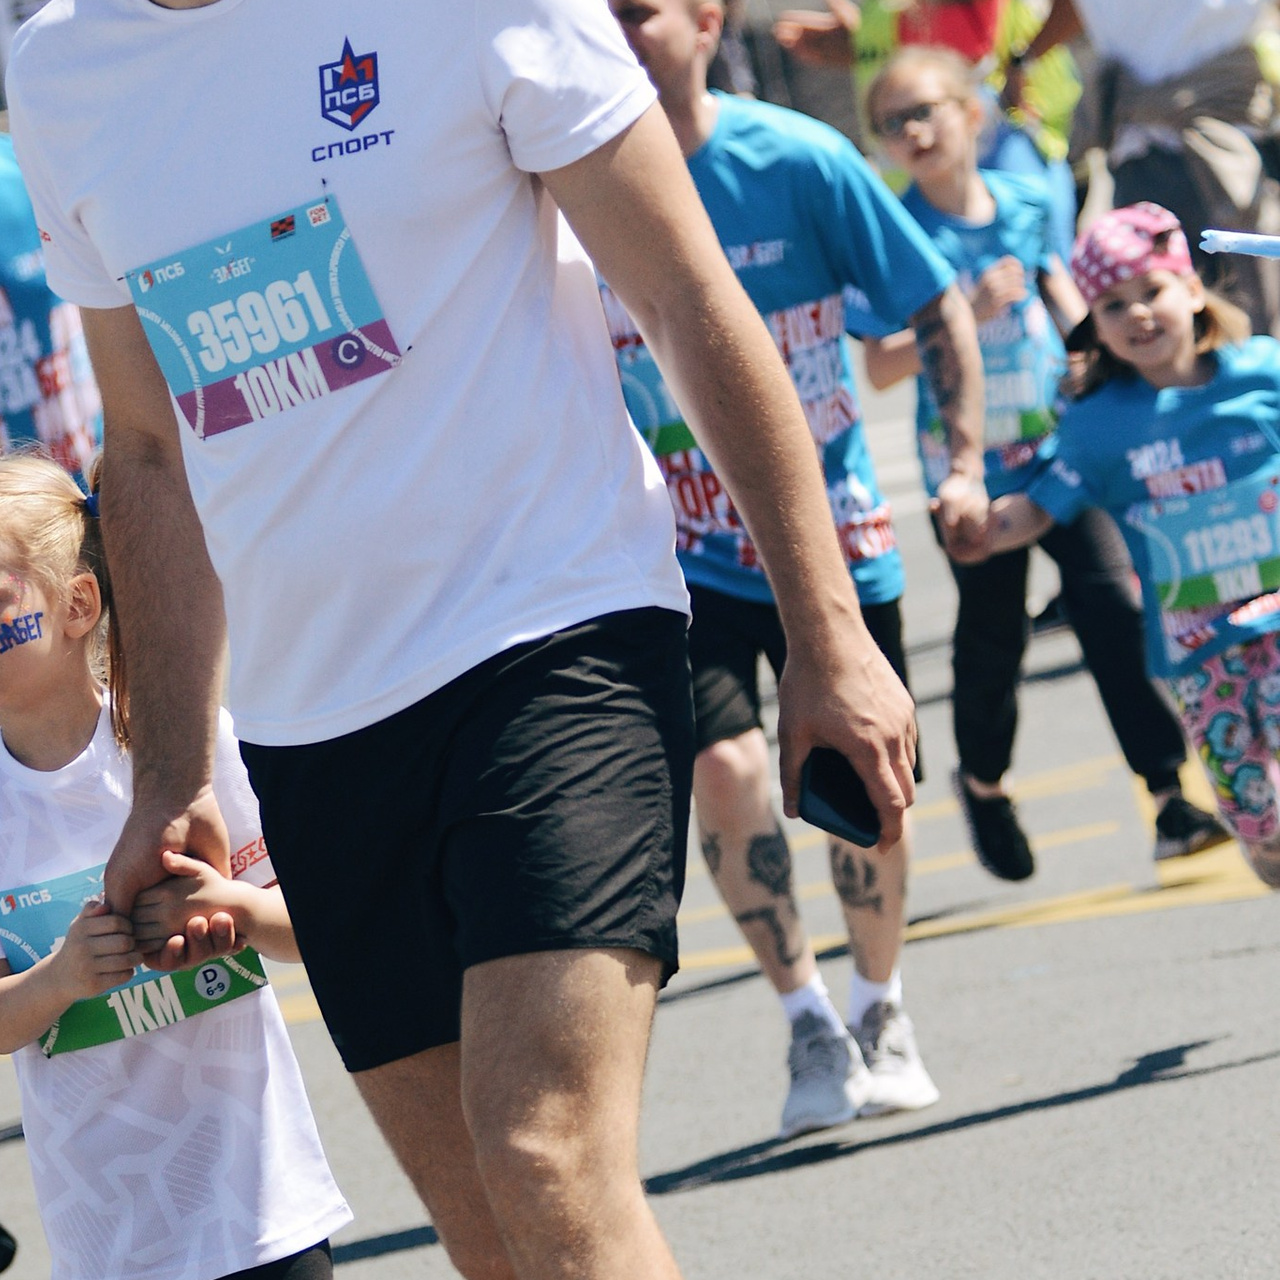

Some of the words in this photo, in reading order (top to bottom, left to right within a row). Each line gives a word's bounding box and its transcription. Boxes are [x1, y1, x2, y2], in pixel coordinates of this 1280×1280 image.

[324, 83, 376, 110] ПСБ
[311, 130, 396, 163] СПОРТ
[154, 261, 186, 285] ПСБ
[186, 270, 333, 373] 35961
[18, 889, 53, 909] ПСБ
[202, 967, 218, 984] D
[206, 981, 226, 997] 6-9
